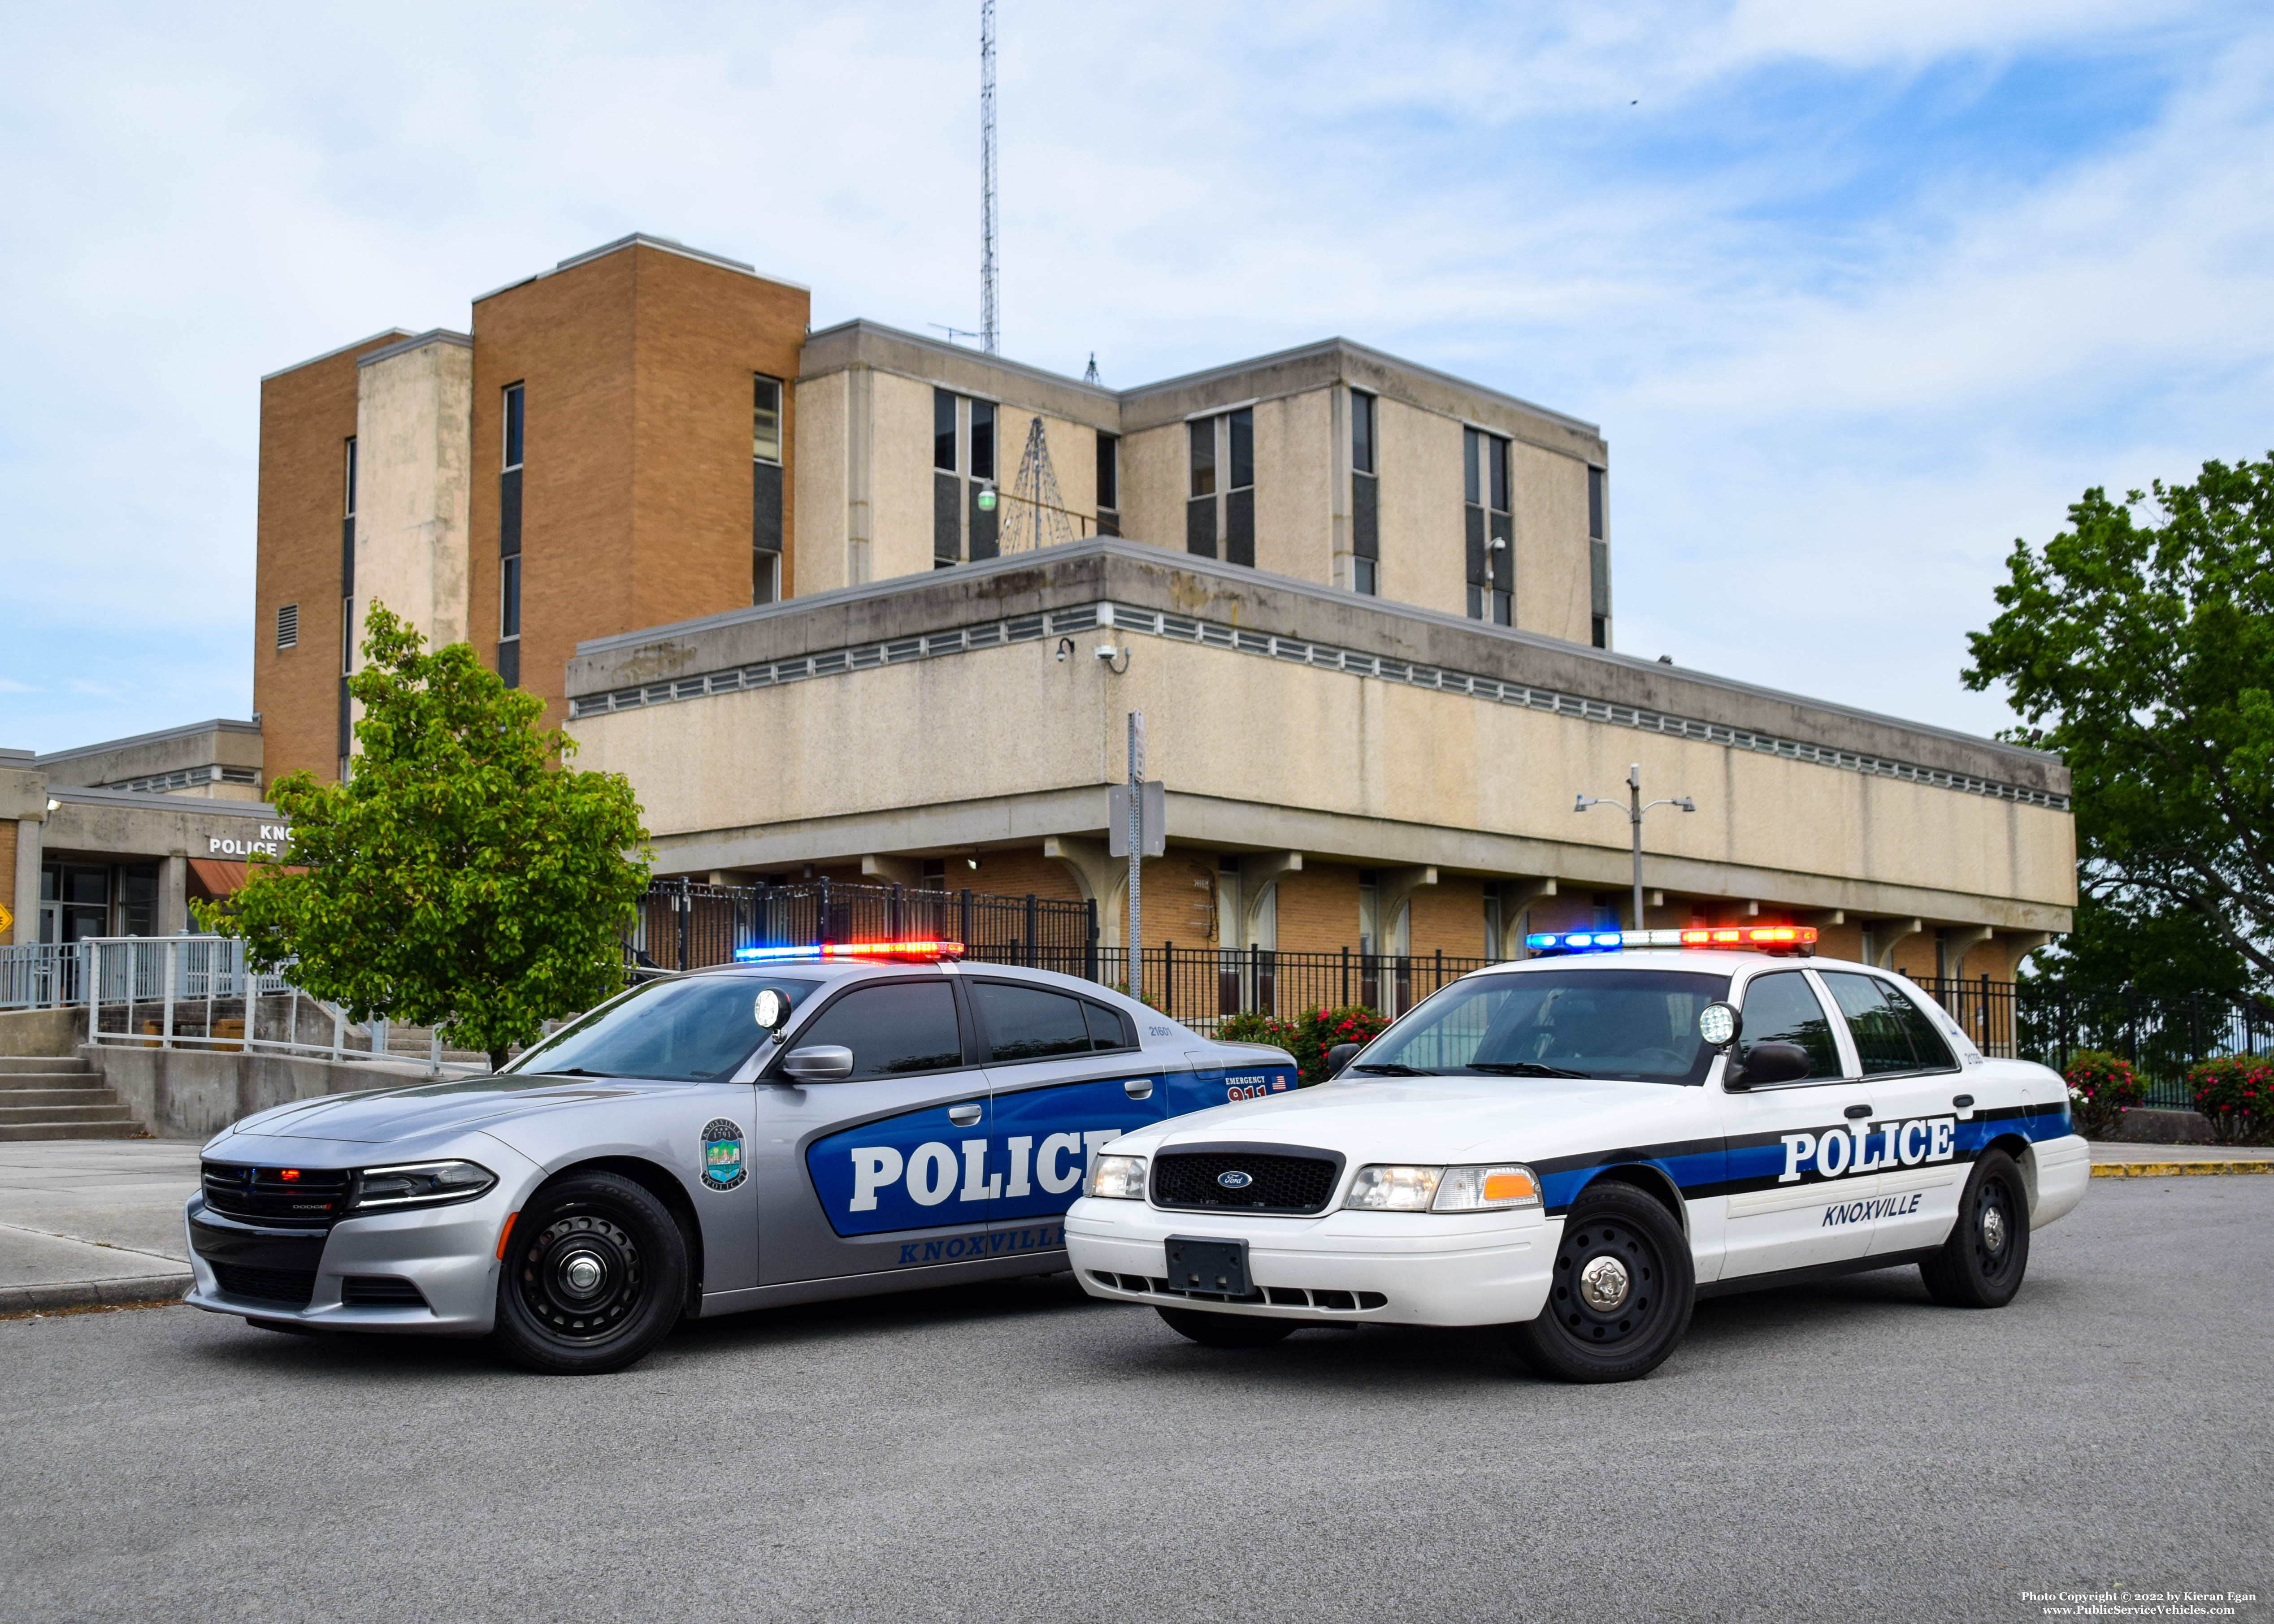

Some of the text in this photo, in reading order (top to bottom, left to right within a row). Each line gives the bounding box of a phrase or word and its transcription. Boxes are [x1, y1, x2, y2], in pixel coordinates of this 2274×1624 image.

[209, 838, 277, 857] POLICE
[1149, 1026, 1172, 1036] 21601
[1225, 1076, 1265, 1085] EMERGENCY
[1227, 1085, 1267, 1103] 911
[703, 1120, 742, 1137] KNOXVILLE
[1778, 1117, 1955, 1182] POLICE
[706, 1177, 742, 1190] POLICE
[1224, 1174, 1243, 1184] Ford
[1822, 1193, 1922, 1227] KNOXVILLE
